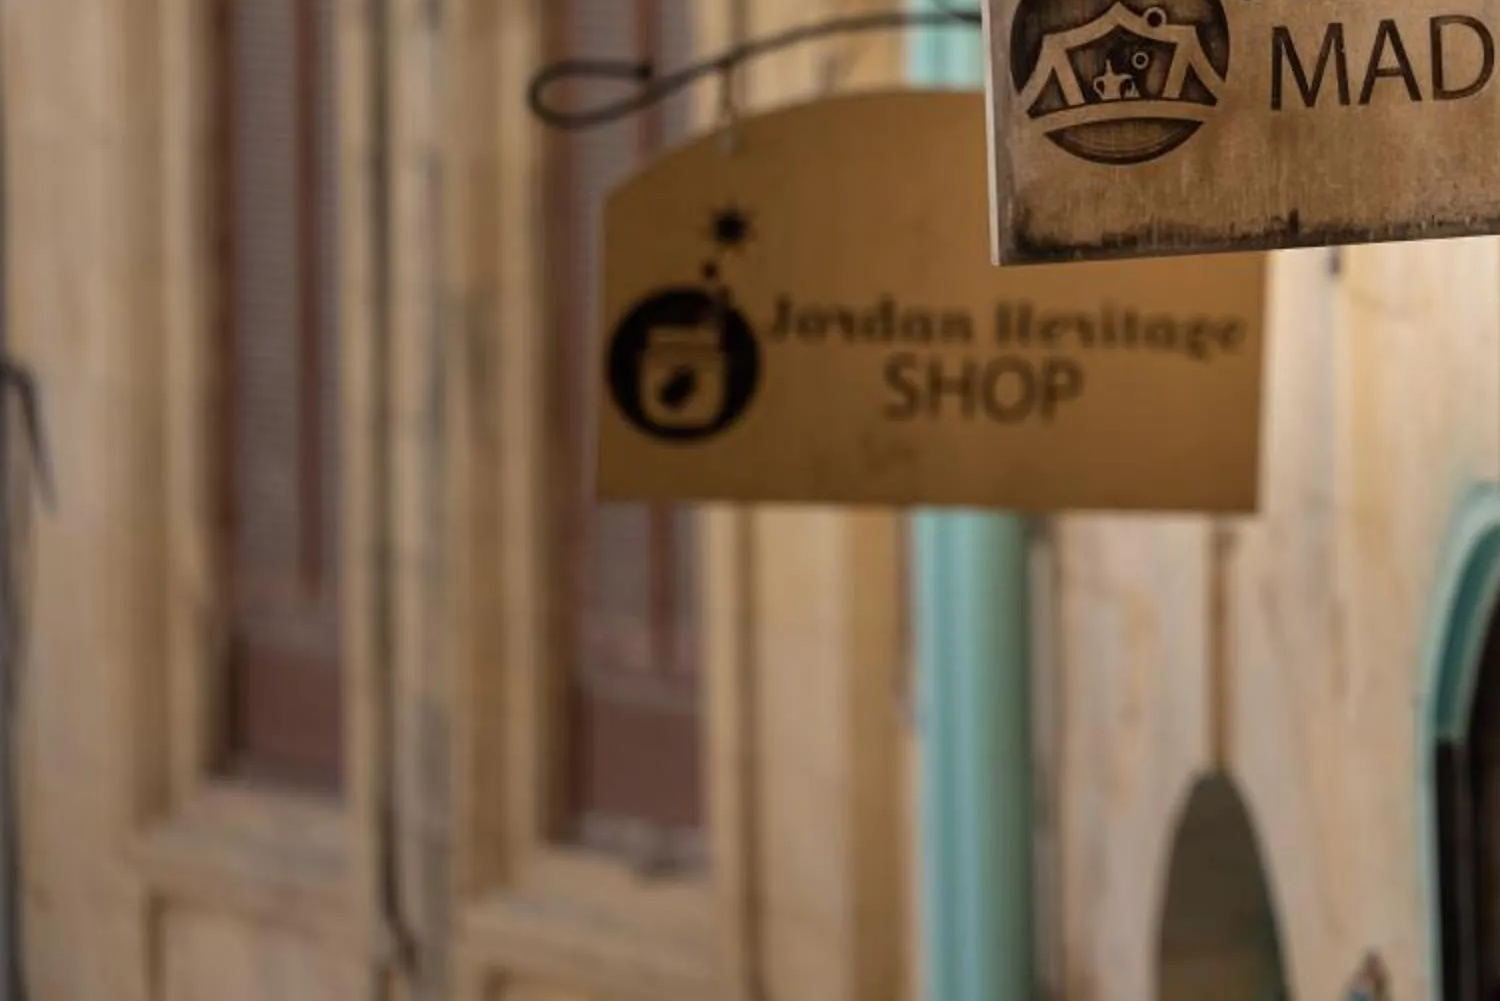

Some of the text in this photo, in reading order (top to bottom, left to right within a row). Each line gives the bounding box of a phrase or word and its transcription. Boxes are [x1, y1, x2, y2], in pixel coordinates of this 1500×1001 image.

[768, 295, 1246, 358] Jordan Heritage
[884, 354, 1085, 424] SHOP
